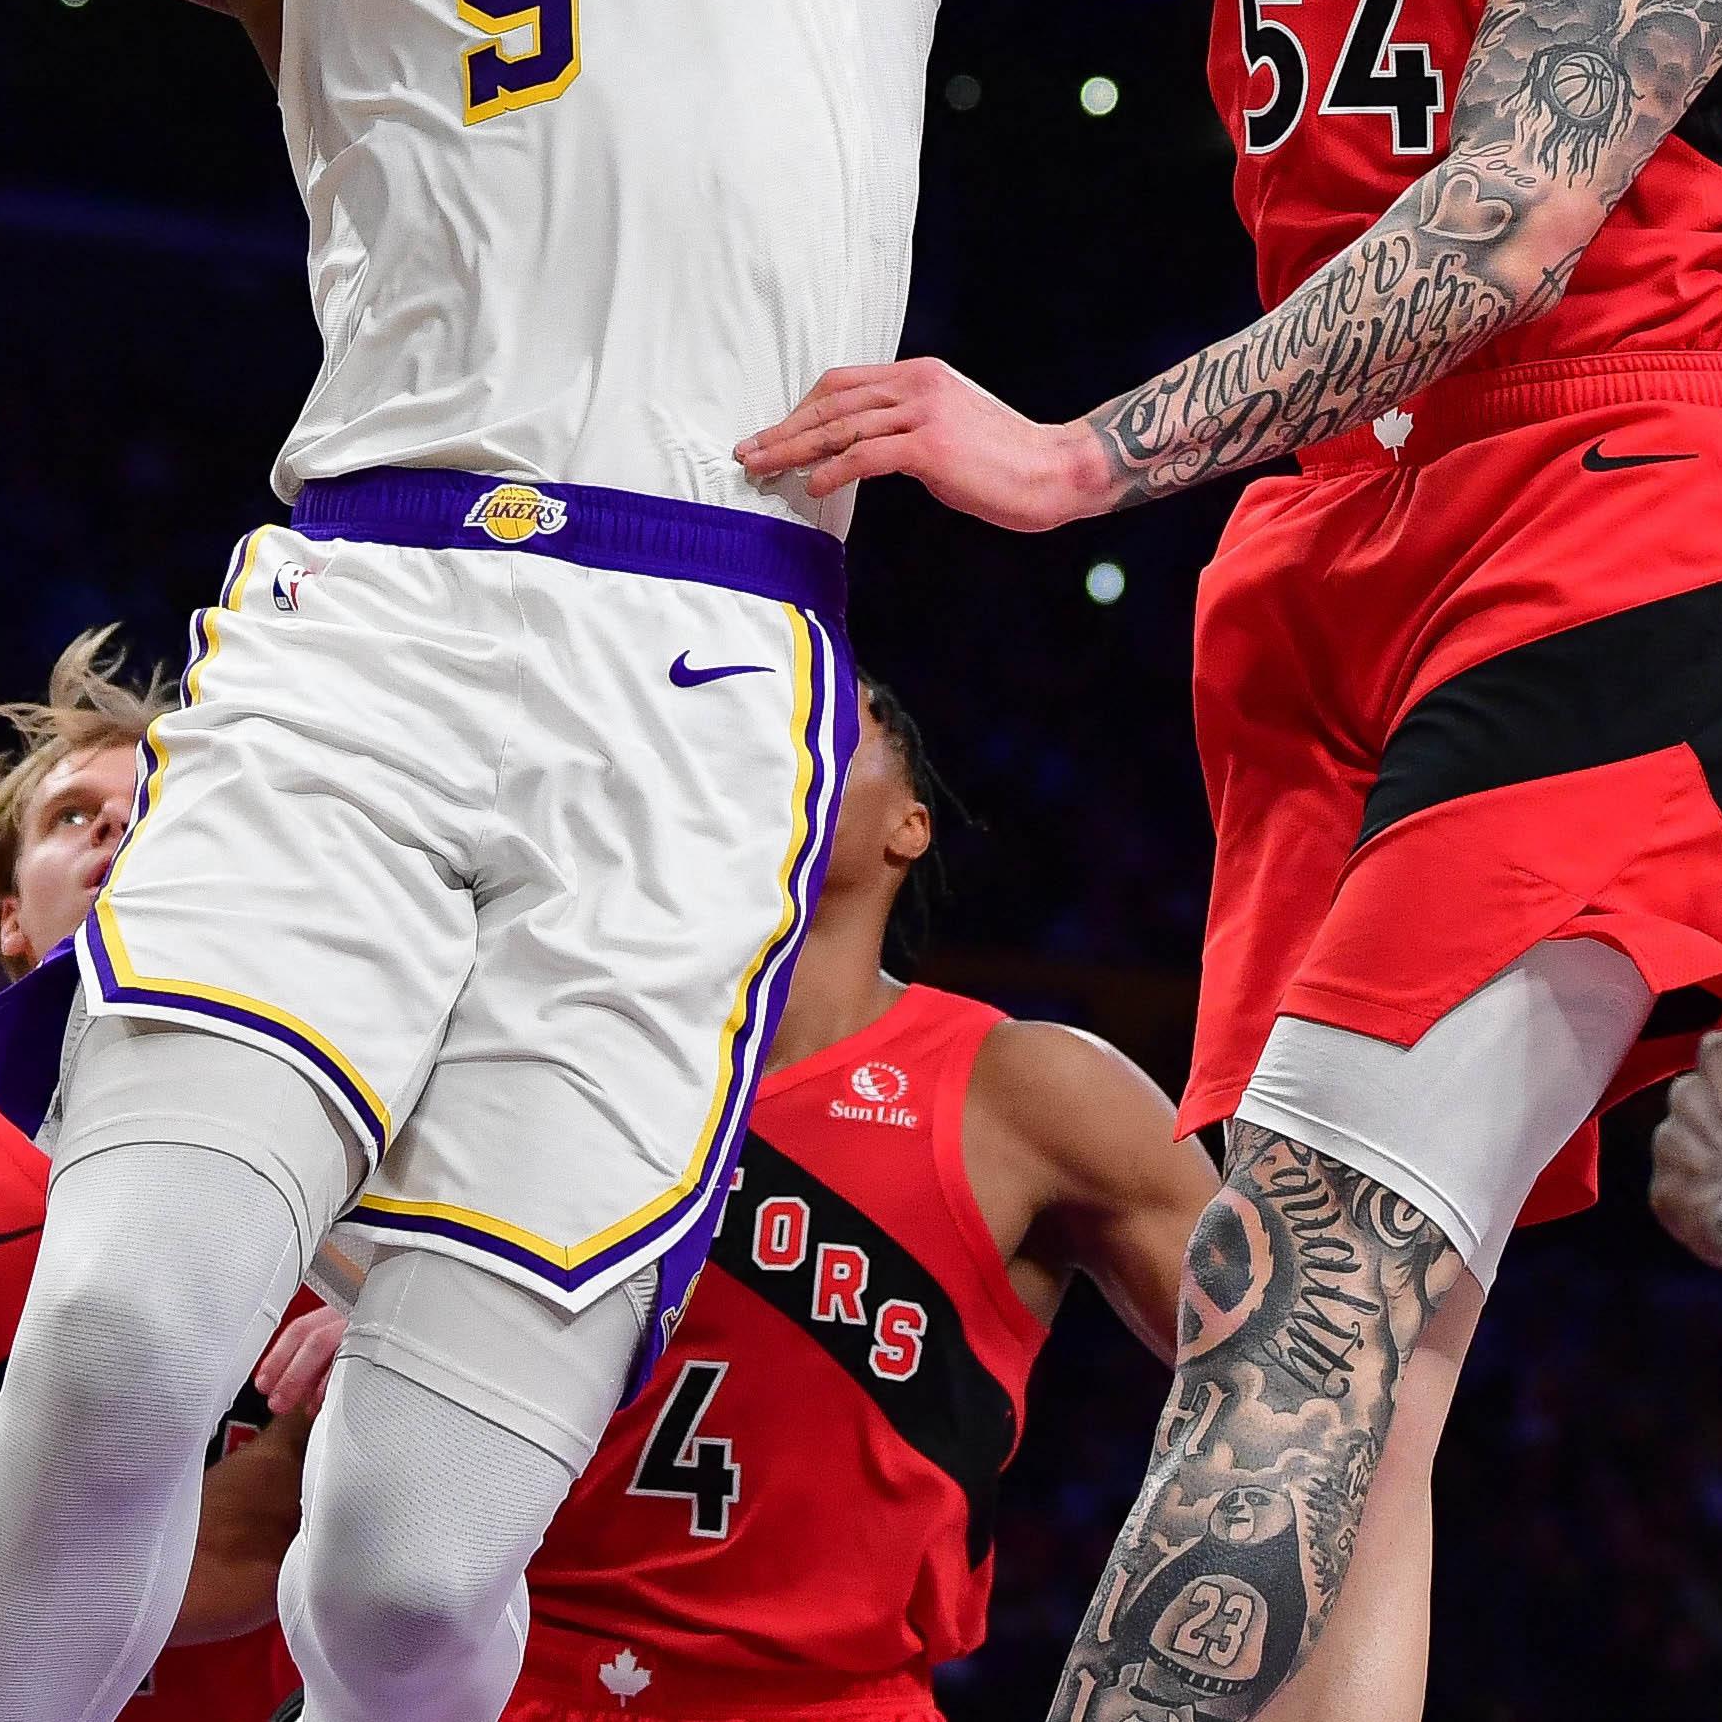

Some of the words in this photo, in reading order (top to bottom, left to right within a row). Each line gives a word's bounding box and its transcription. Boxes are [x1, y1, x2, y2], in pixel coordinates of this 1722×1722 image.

[467, 494, 564, 531] LAKERS
[830, 1099, 873, 1121] Sun
[876, 1106, 918, 1129] Life
[625, 1360, 741, 1540] 4
[1172, 1581, 1255, 1668] 23
